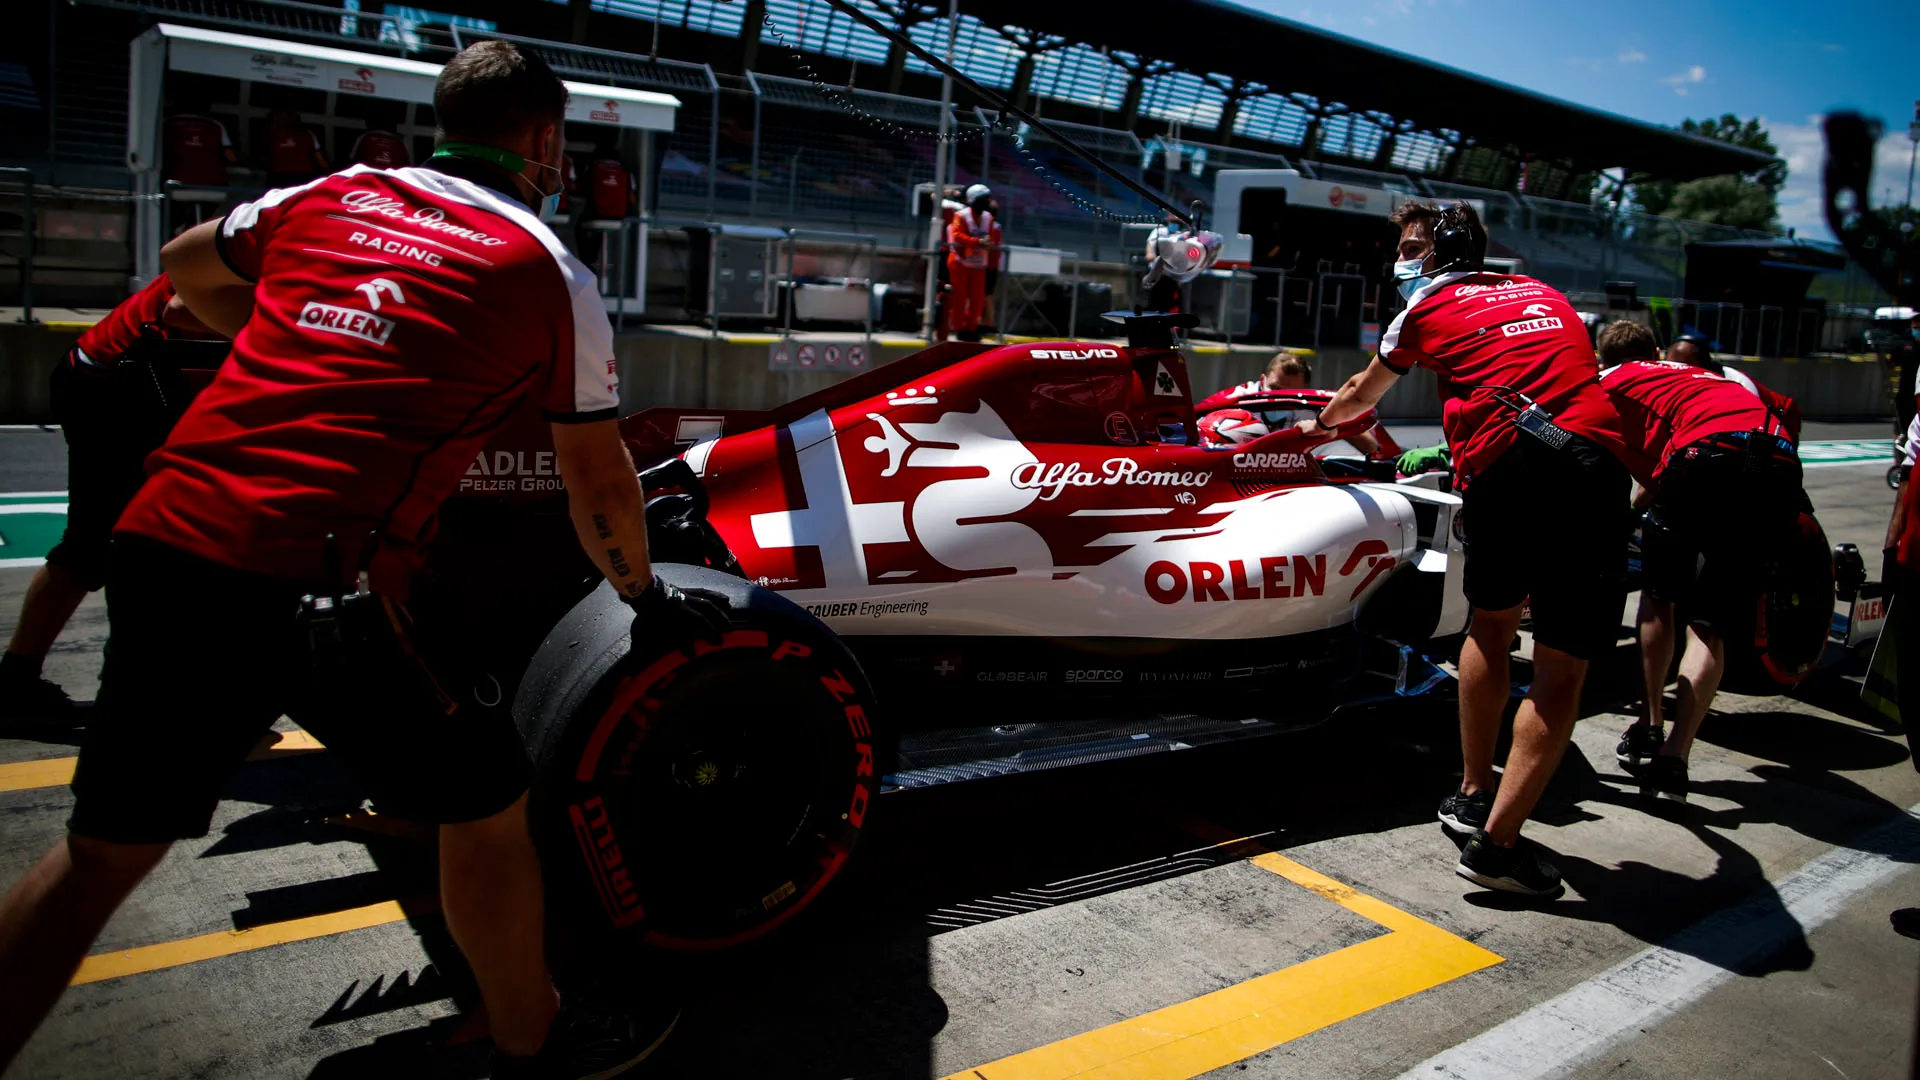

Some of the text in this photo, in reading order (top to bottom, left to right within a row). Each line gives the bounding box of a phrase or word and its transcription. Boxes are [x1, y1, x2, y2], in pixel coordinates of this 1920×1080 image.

[341, 190, 508, 247] Alfa Romeo
[348, 231, 443, 268] RACING
[1485, 290, 1544, 303] RACING
[305, 306, 387, 340] ORLEN
[1506, 319, 1559, 334] ORLEN
[1030, 349, 1118, 361] STELVIO
[1232, 452, 1308, 468] CARRERA
[460, 478, 566, 492] PELZER GROU
[1011, 457, 1213, 501] Alfa Romeo
[1144, 554, 1327, 605] ORLEN
[806, 600, 929, 618] SAUBER Engineering
[976, 669, 1124, 684] GLOBEAIR sparco
[769, 639, 874, 829] P ZERO
[568, 795, 649, 929] PIRELLI
